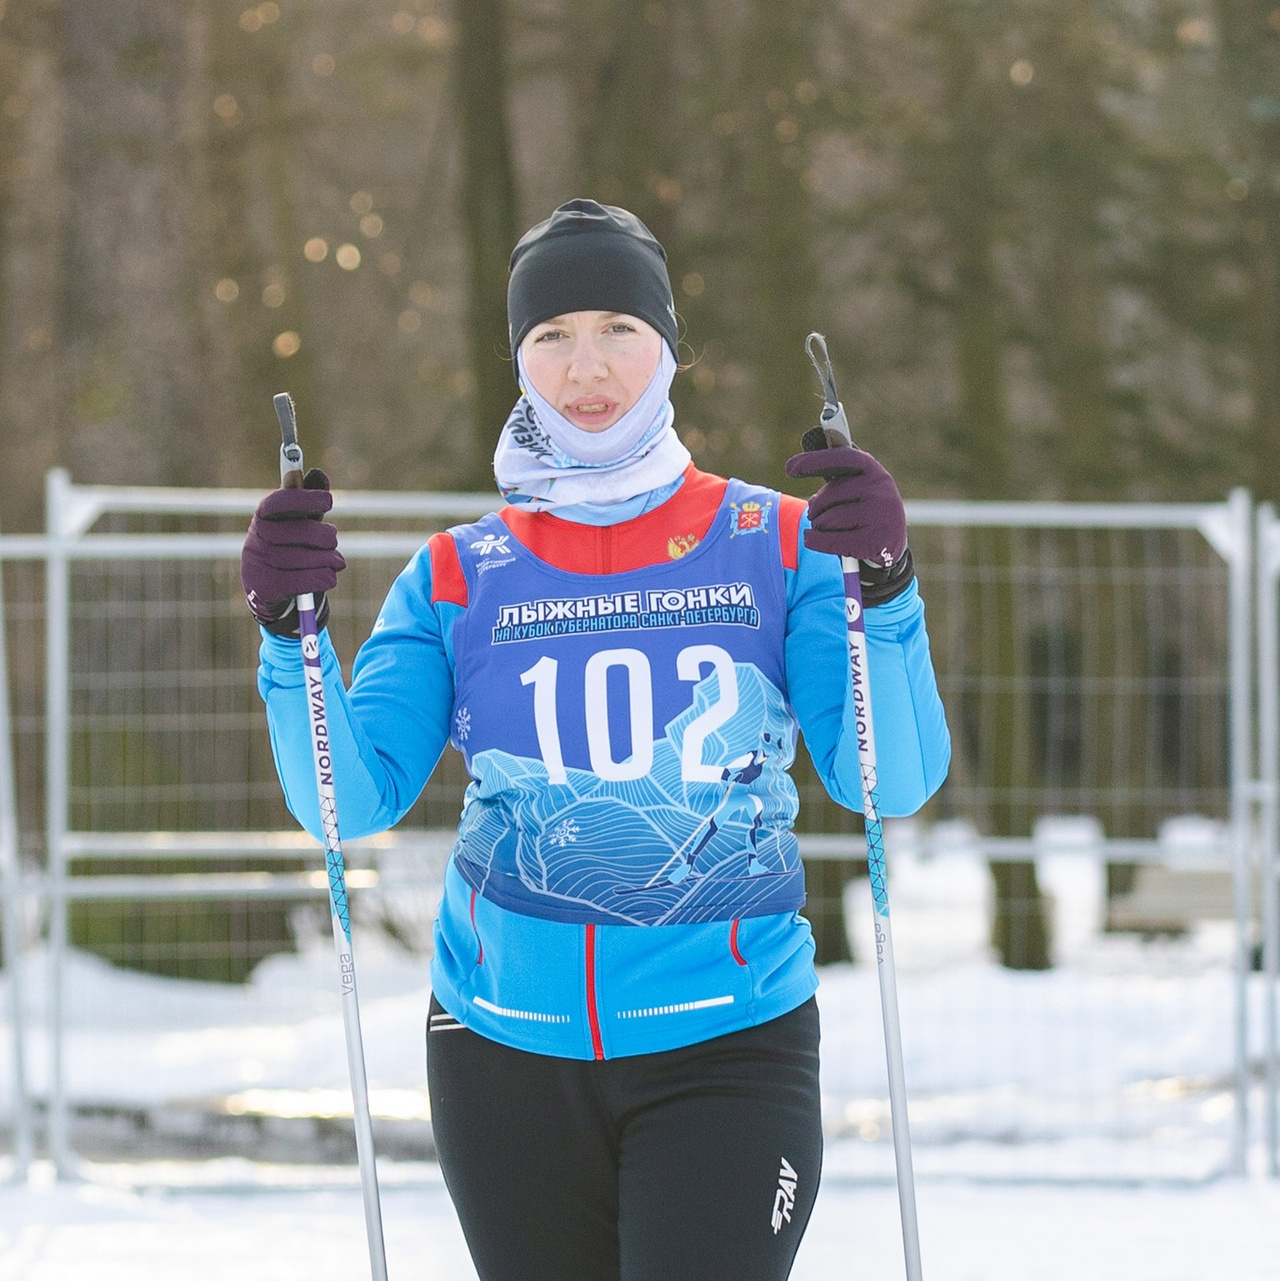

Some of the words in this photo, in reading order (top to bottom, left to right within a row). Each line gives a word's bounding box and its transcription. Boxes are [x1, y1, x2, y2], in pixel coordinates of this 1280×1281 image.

[494, 625, 512, 642] НА
[513, 622, 553, 640] КУБОК
[554, 614, 638, 635] ГУБЕРНАТОРА
[641, 607, 758, 628] САНКТ-ПЕТЕРБУРГА
[500, 593, 639, 627] ЛЫЖНЫЕ
[648, 583, 754, 613] ГОНКИ
[309, 676, 333, 786] NORDWAY
[520, 644, 739, 785] 102
[848, 640, 869, 752] NORDWAY
